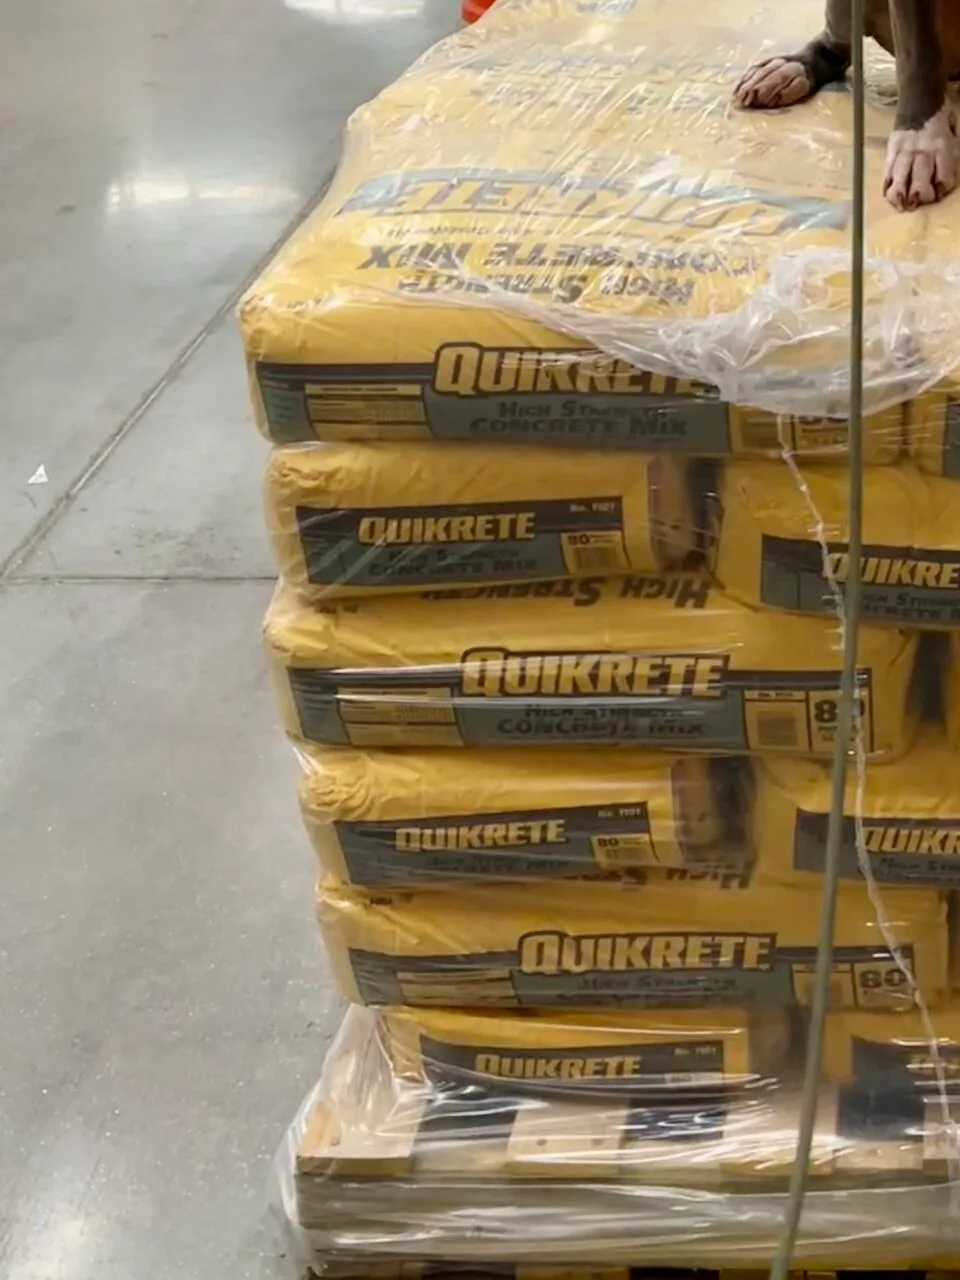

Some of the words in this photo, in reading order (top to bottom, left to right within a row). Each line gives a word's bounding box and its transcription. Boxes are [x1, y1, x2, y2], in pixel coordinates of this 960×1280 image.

[358, 242, 472, 270] MIX
[358, 512, 537, 547] QUIKRETE
[567, 533, 591, 546] 80
[618, 577, 715, 609] HIGH
[462, 650, 724, 699] QUIKRETE
[395, 819, 568, 853] QUIKRETE
[520, 933, 772, 976] QUIKRETE
[474, 1052, 643, 1080] QUIKRETE
